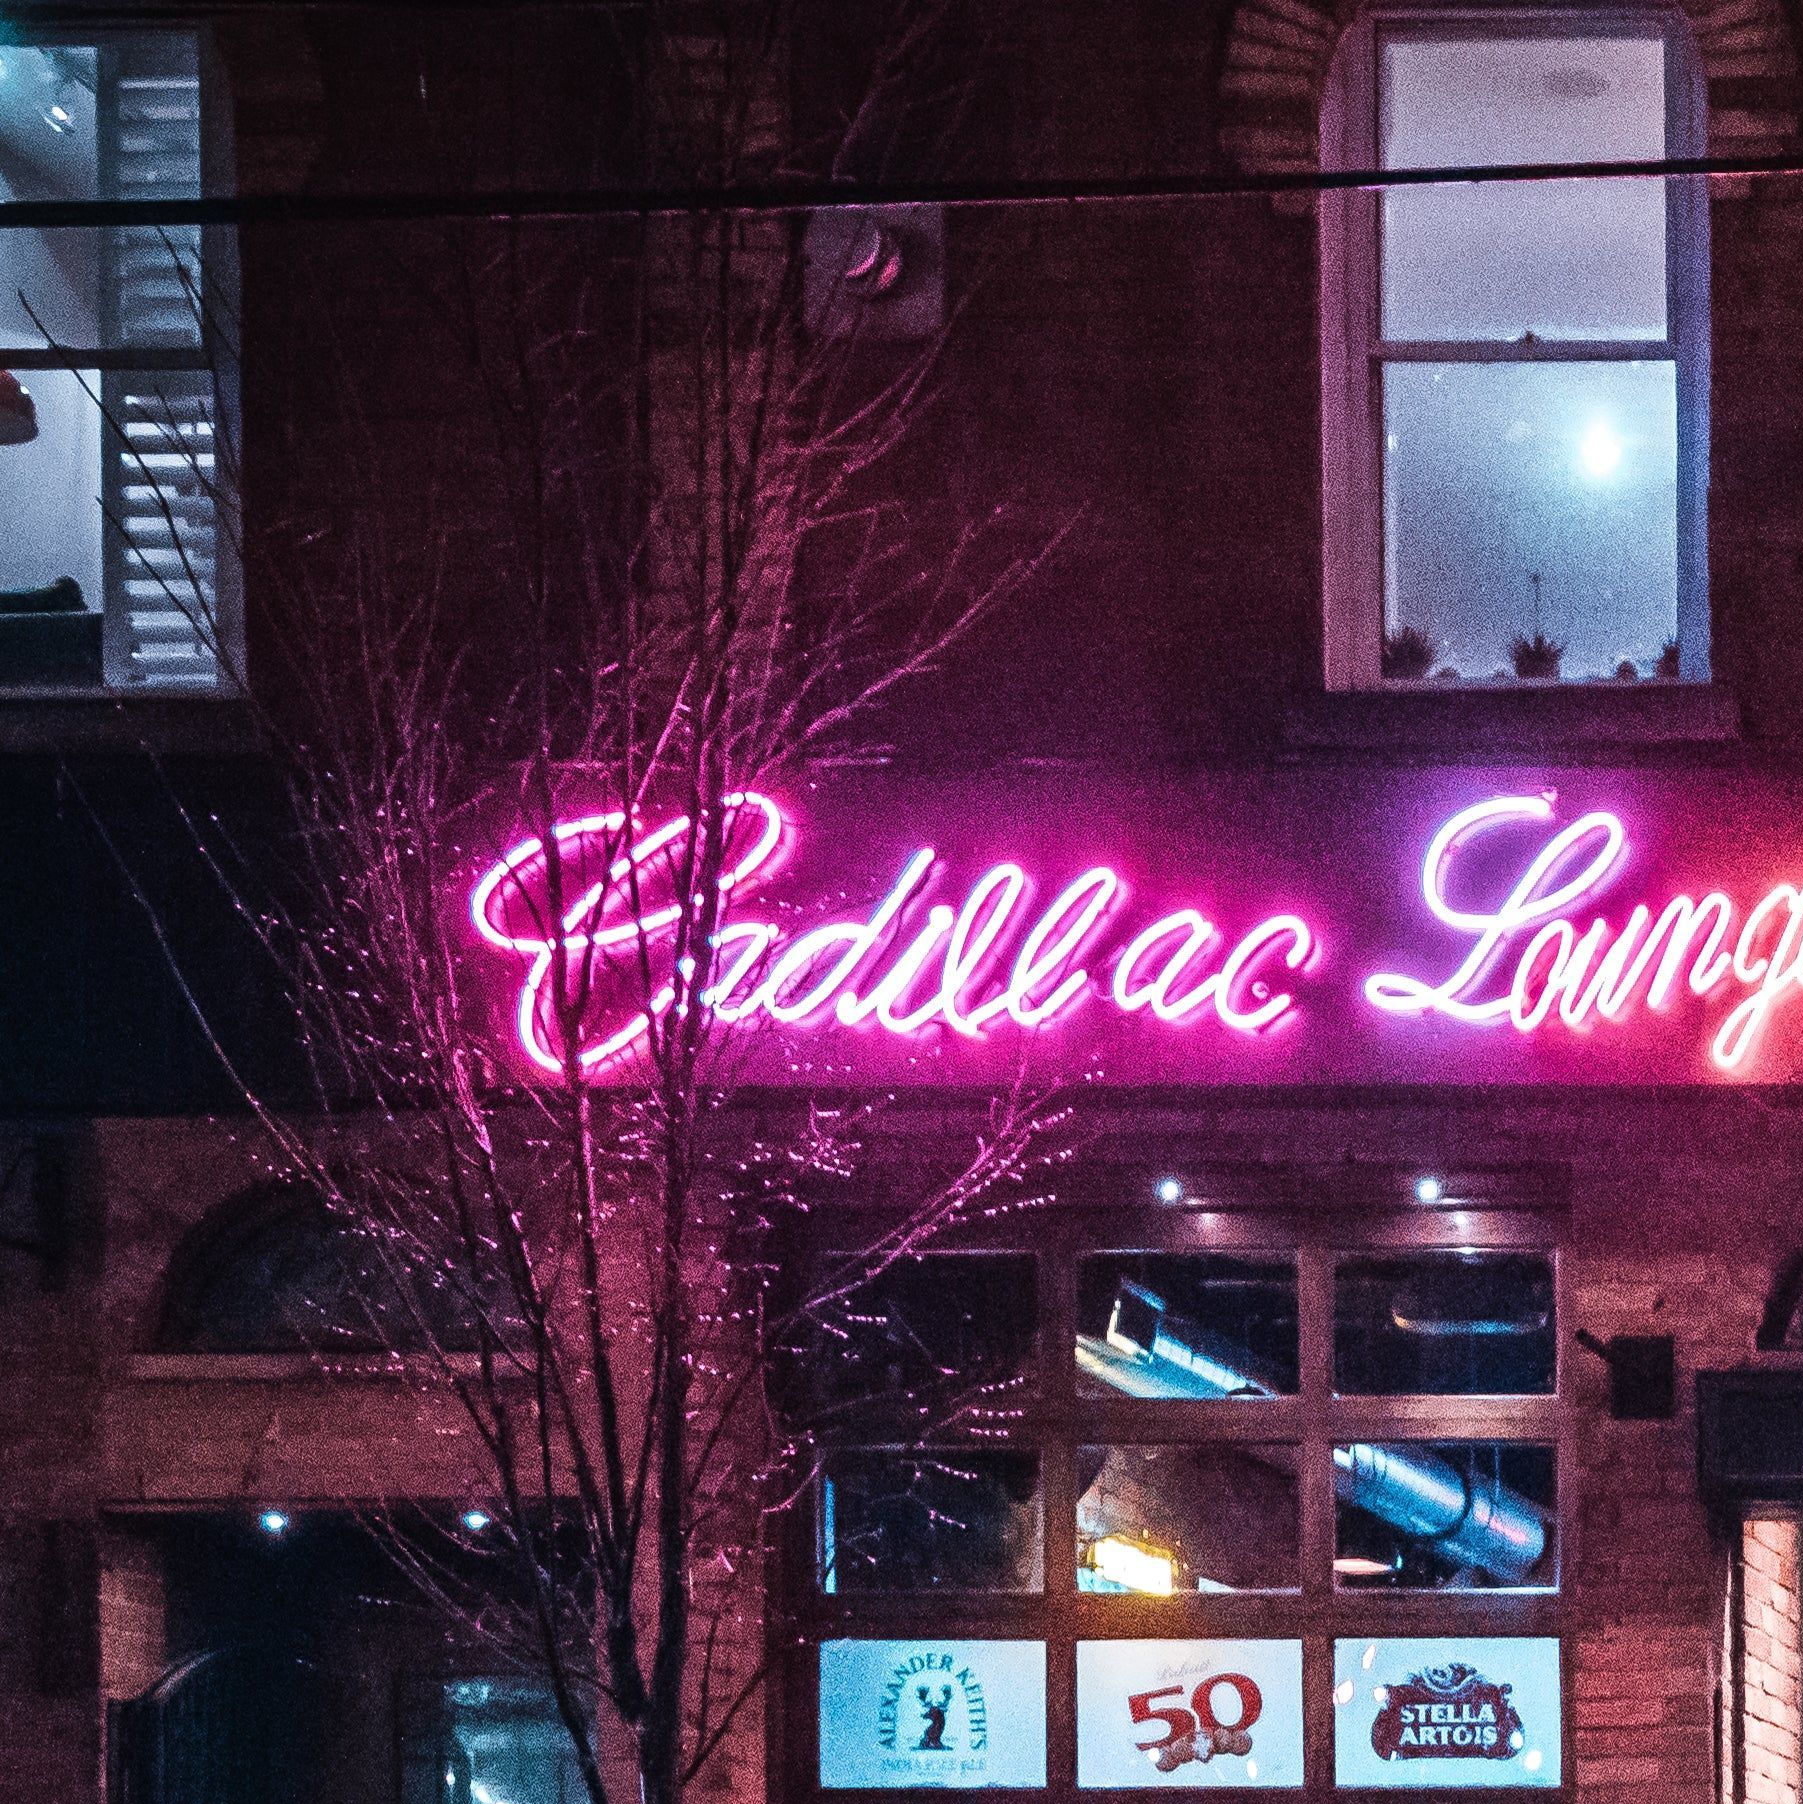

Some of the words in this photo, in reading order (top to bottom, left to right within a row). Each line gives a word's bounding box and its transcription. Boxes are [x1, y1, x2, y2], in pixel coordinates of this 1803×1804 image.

[471, 790, 1319, 1073] Cadillac
[878, 1652, 953, 1750] ALEXANDER
[1128, 1673, 1262, 1752] 50
[1400, 1703, 1497, 1723] STELLA
[1400, 1725, 1498, 1746] ARTOIS
